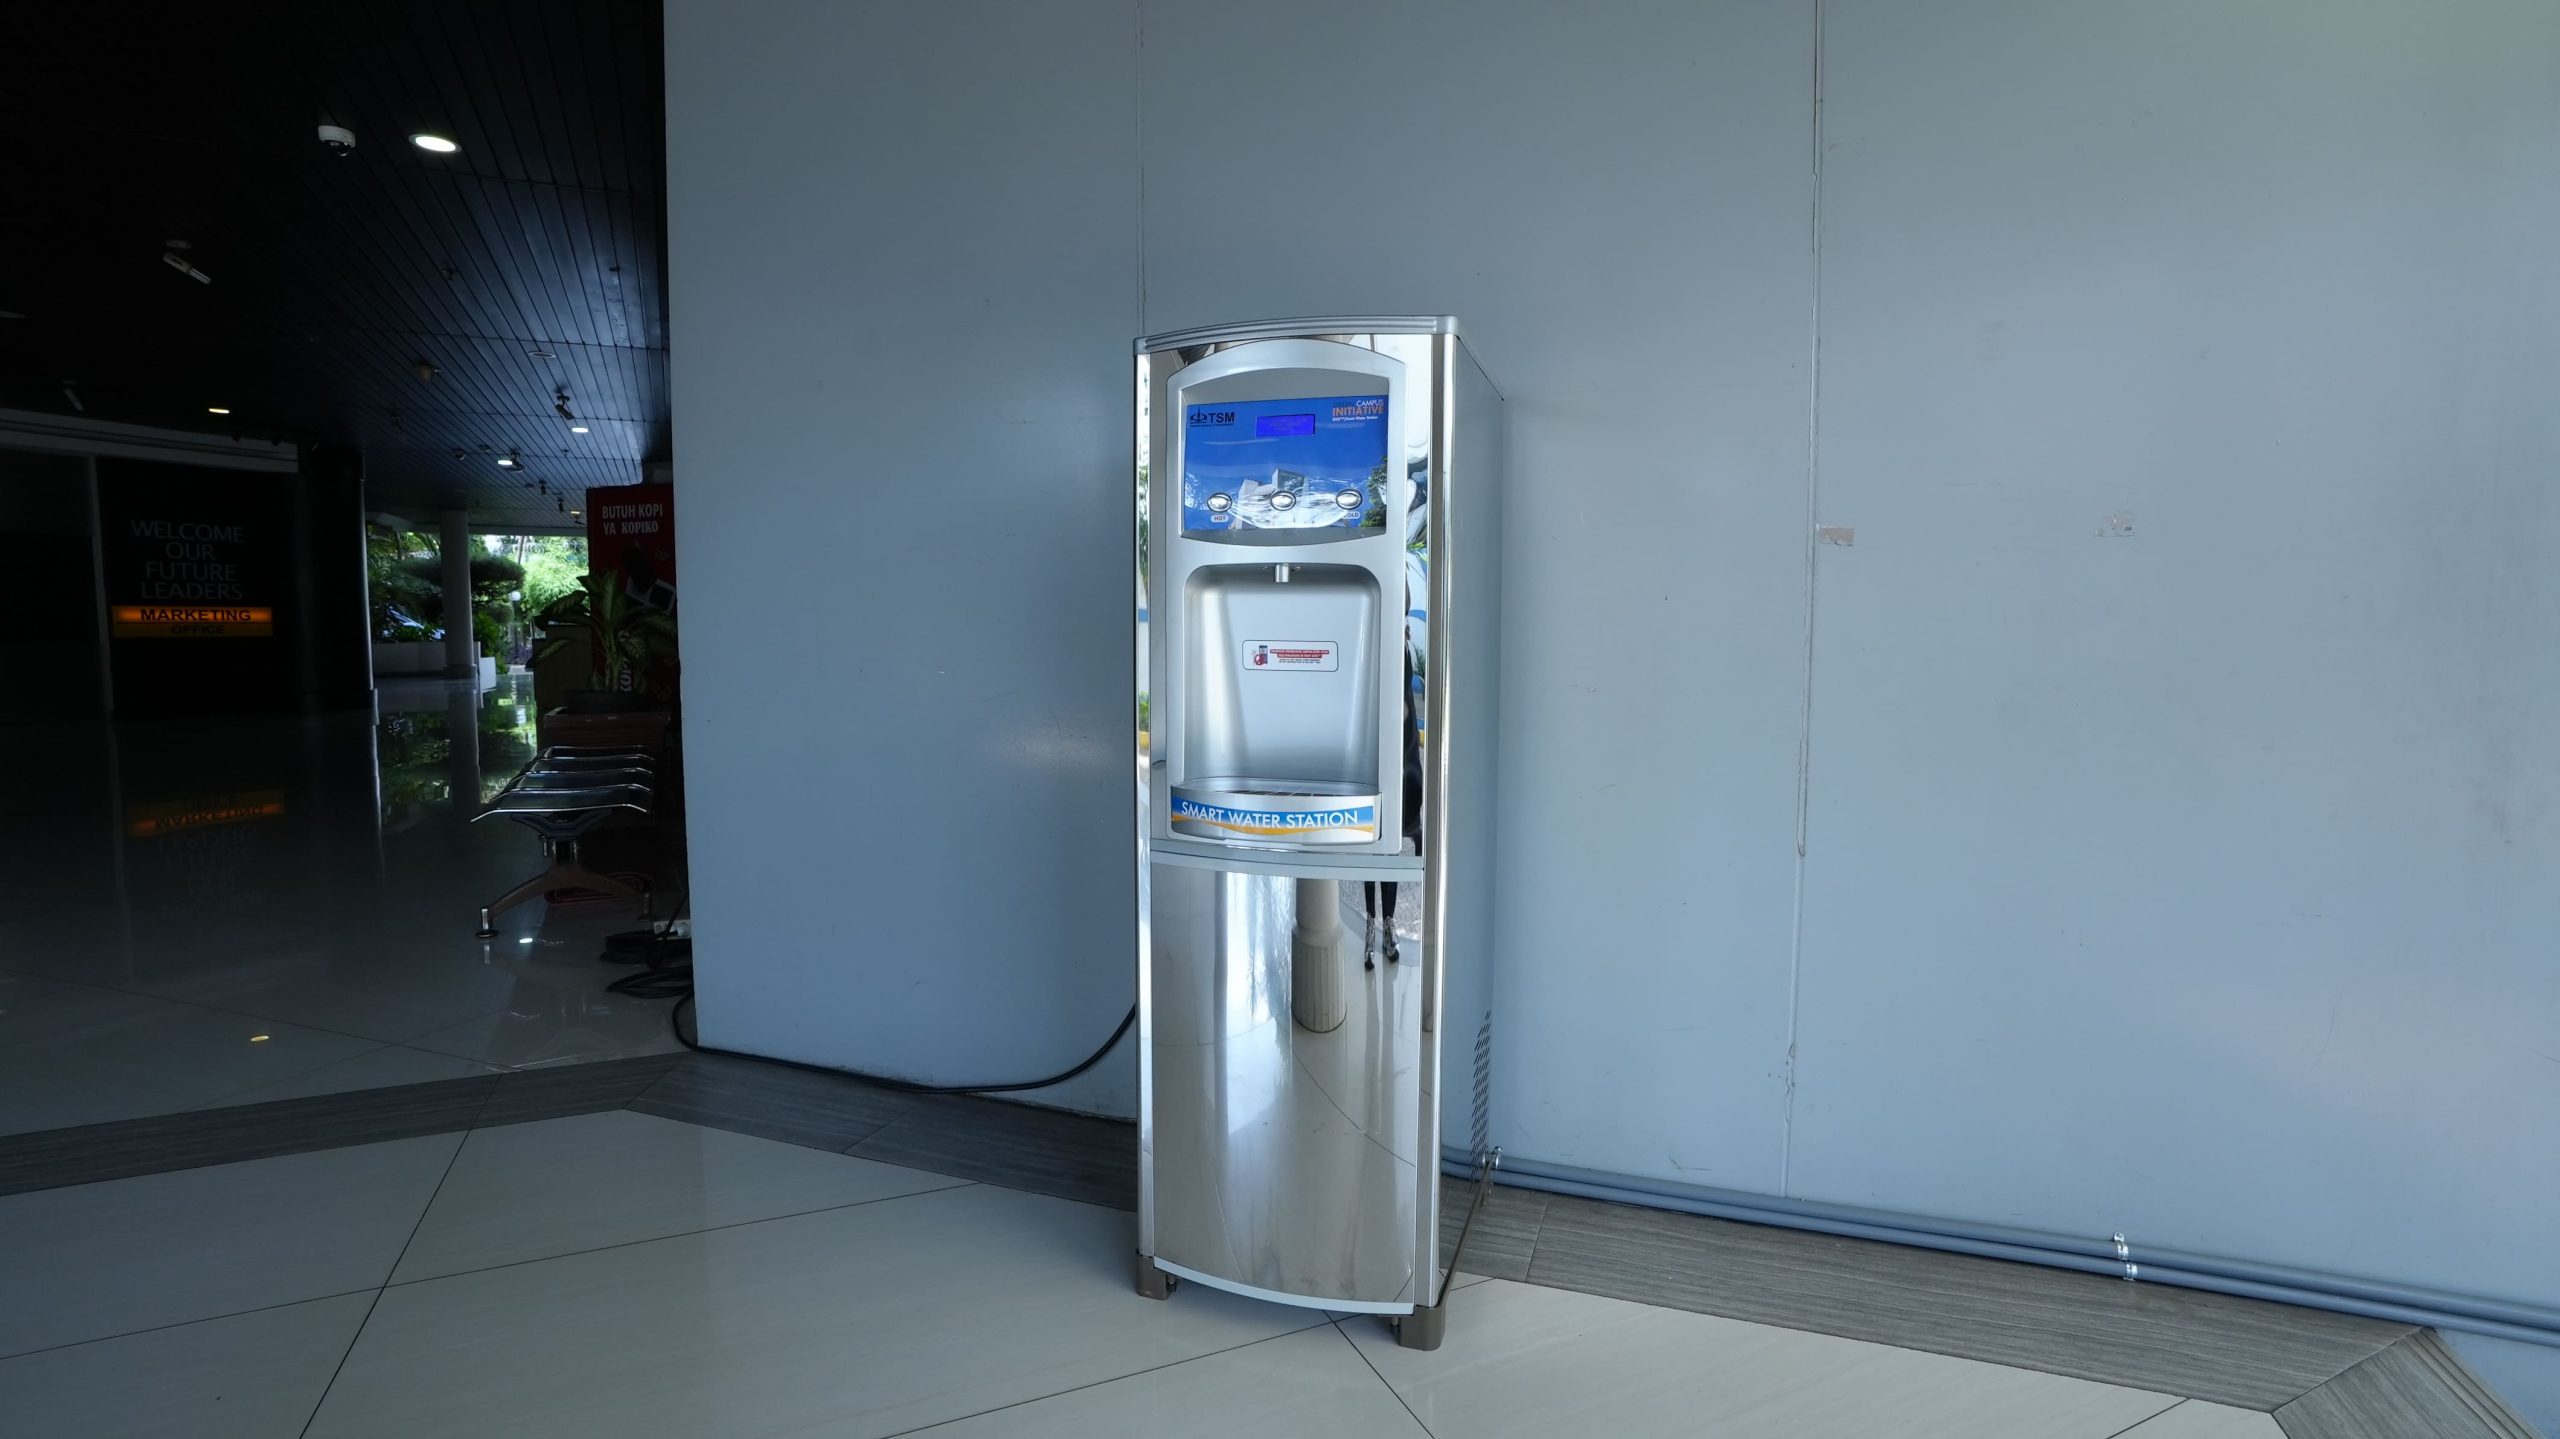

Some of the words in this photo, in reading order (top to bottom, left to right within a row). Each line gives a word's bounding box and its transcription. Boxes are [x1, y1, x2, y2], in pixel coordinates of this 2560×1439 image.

[1332, 405, 1384, 417] INITIATIVE
[1356, 399, 1384, 407] CAMPUS
[1208, 411, 1235, 424] TSM
[602, 504, 636, 519] BUTUH
[638, 503, 663, 518] KOPI
[129, 519, 247, 544] WELCOME
[603, 521, 617, 536] YA
[621, 520, 659, 535] KOPIKO
[165, 541, 217, 561] OUR
[145, 560, 240, 582] FUTURE
[140, 582, 244, 600] LEADERS
[140, 608, 251, 621] MARKETING
[171, 624, 225, 634] OFFICE
[1181, 801, 1225, 823] SMART
[1228, 811, 1281, 829] WATER
[1286, 810, 1358, 829] STATION
